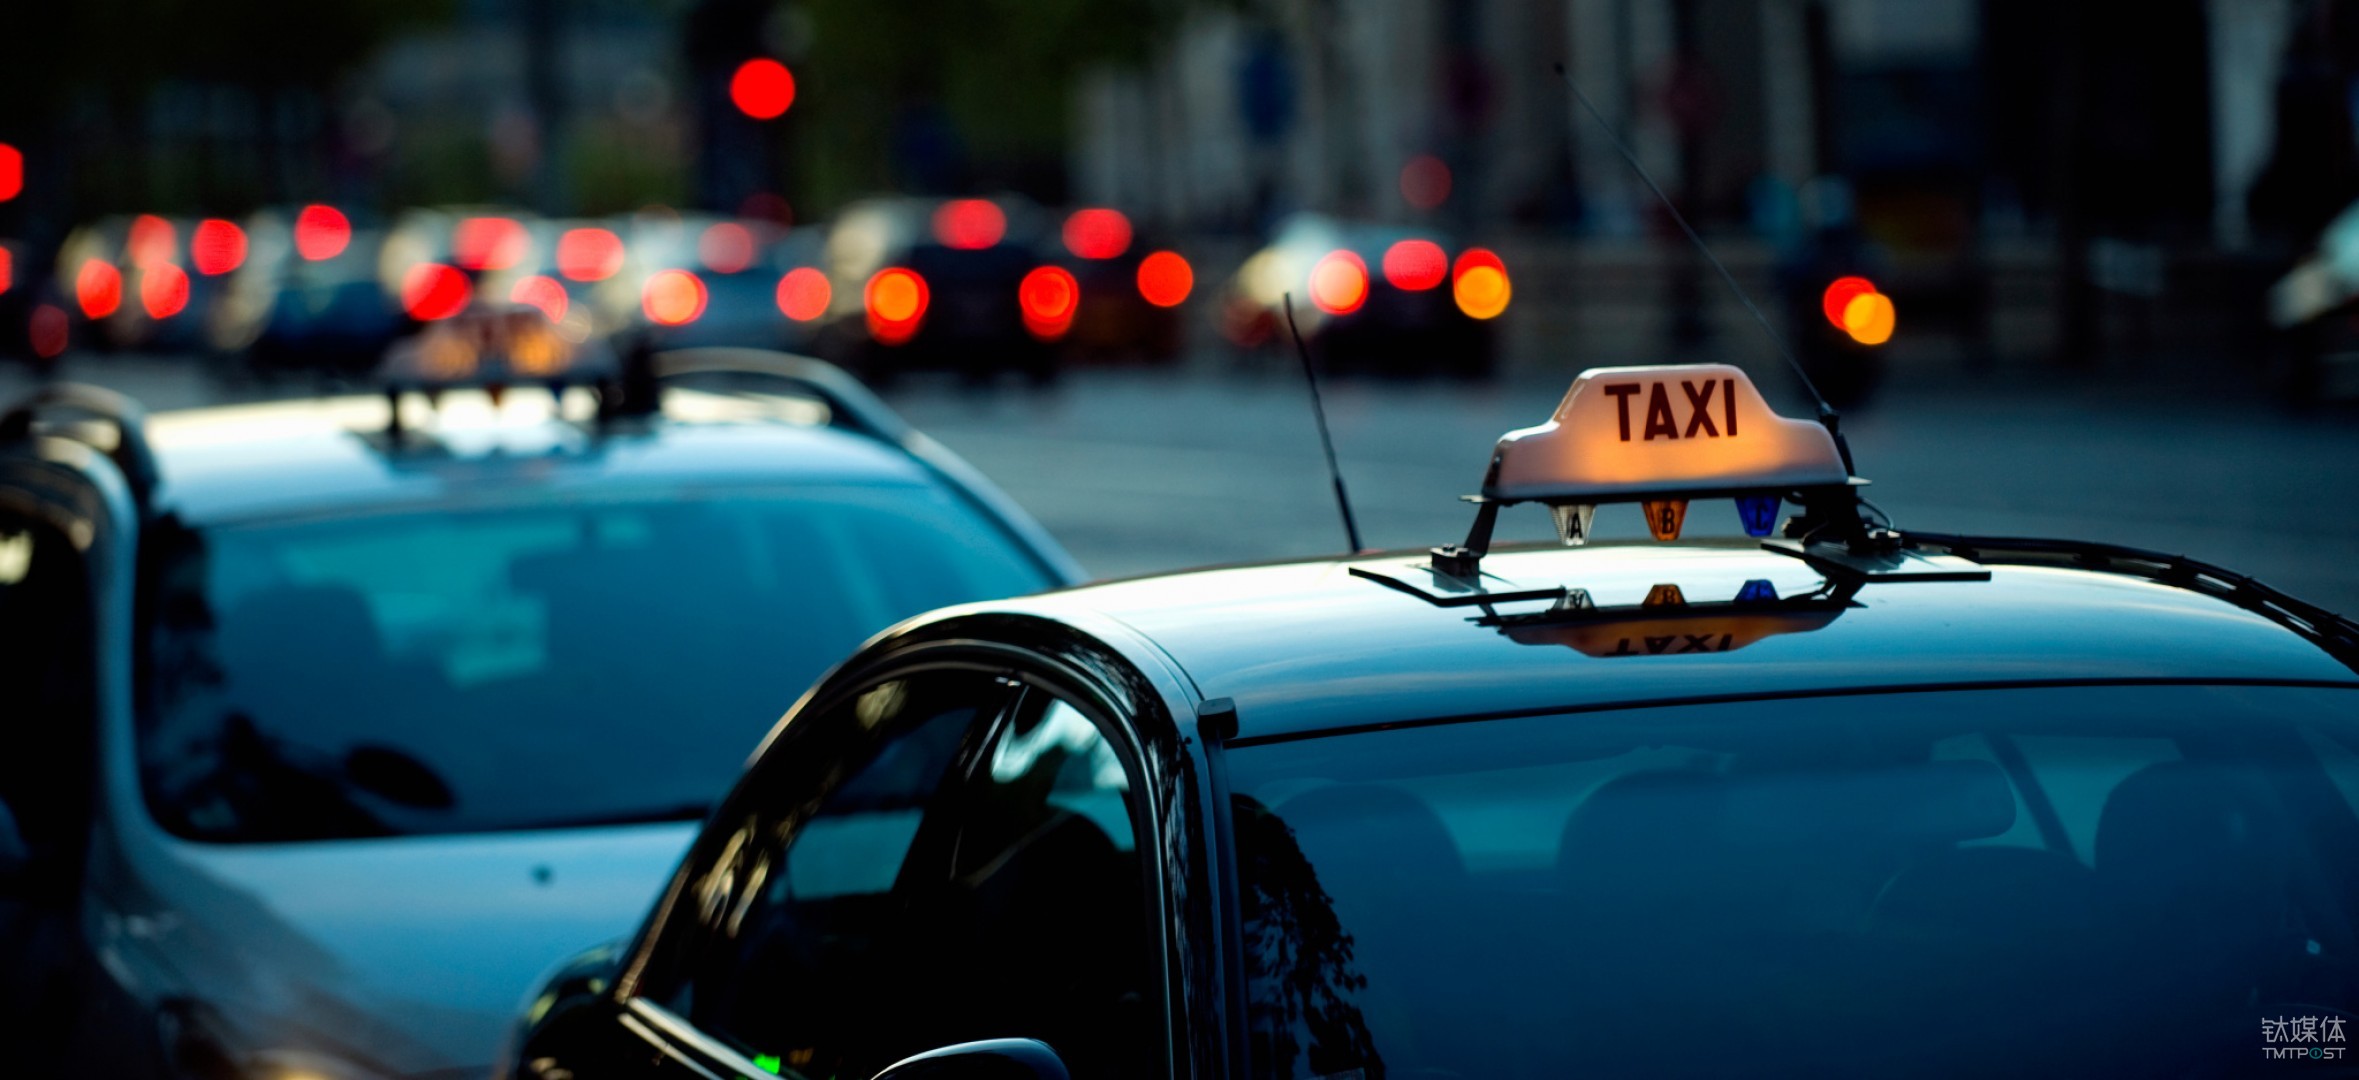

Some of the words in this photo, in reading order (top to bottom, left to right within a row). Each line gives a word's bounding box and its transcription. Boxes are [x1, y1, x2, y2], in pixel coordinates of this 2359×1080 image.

[1604, 378, 1738, 442] TAXI
[1569, 512, 1583, 538] A
[1661, 508, 1675, 534] B
[1755, 503, 1769, 530] C
